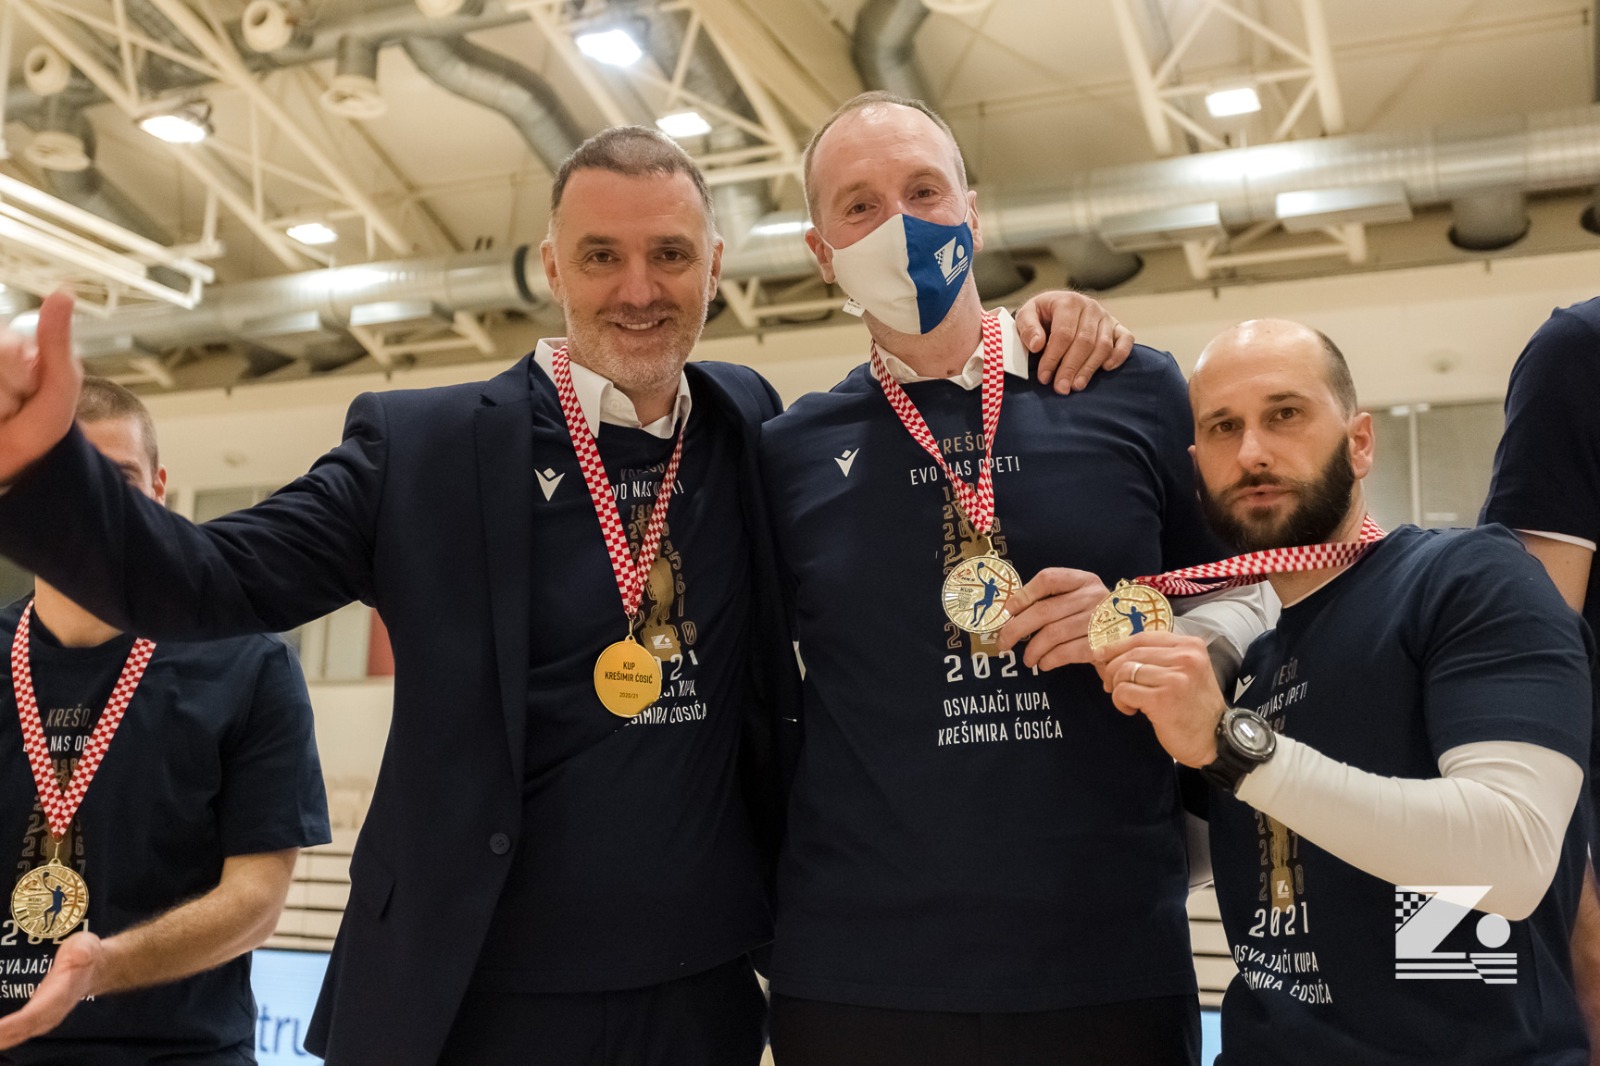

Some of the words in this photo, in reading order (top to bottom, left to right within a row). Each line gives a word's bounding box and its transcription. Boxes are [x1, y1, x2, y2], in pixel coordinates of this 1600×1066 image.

[910, 466, 938, 485] EVO
[633, 481, 652, 498] NAS
[623, 661, 636, 670] KUP
[605, 671, 634, 682] KREŠIMIR
[635, 673, 653, 684] ĆOSIĆ
[670, 700, 707, 723] ĆOSIĆA
[943, 689, 1010, 717] OSVAJAČI
[1015, 692, 1050, 711] KUPA
[938, 720, 1008, 746] KREŠIMIRA
[1014, 715, 1063, 740] ĆOSIĆA
[50, 735, 71, 752] NAS
[1249, 902, 1309, 938] 2021
[1234, 945, 1293, 974] OSVAJAČI
[1294, 952, 1319, 975] KUPA
[1290, 979, 1333, 1004] ĆOSIĆA
